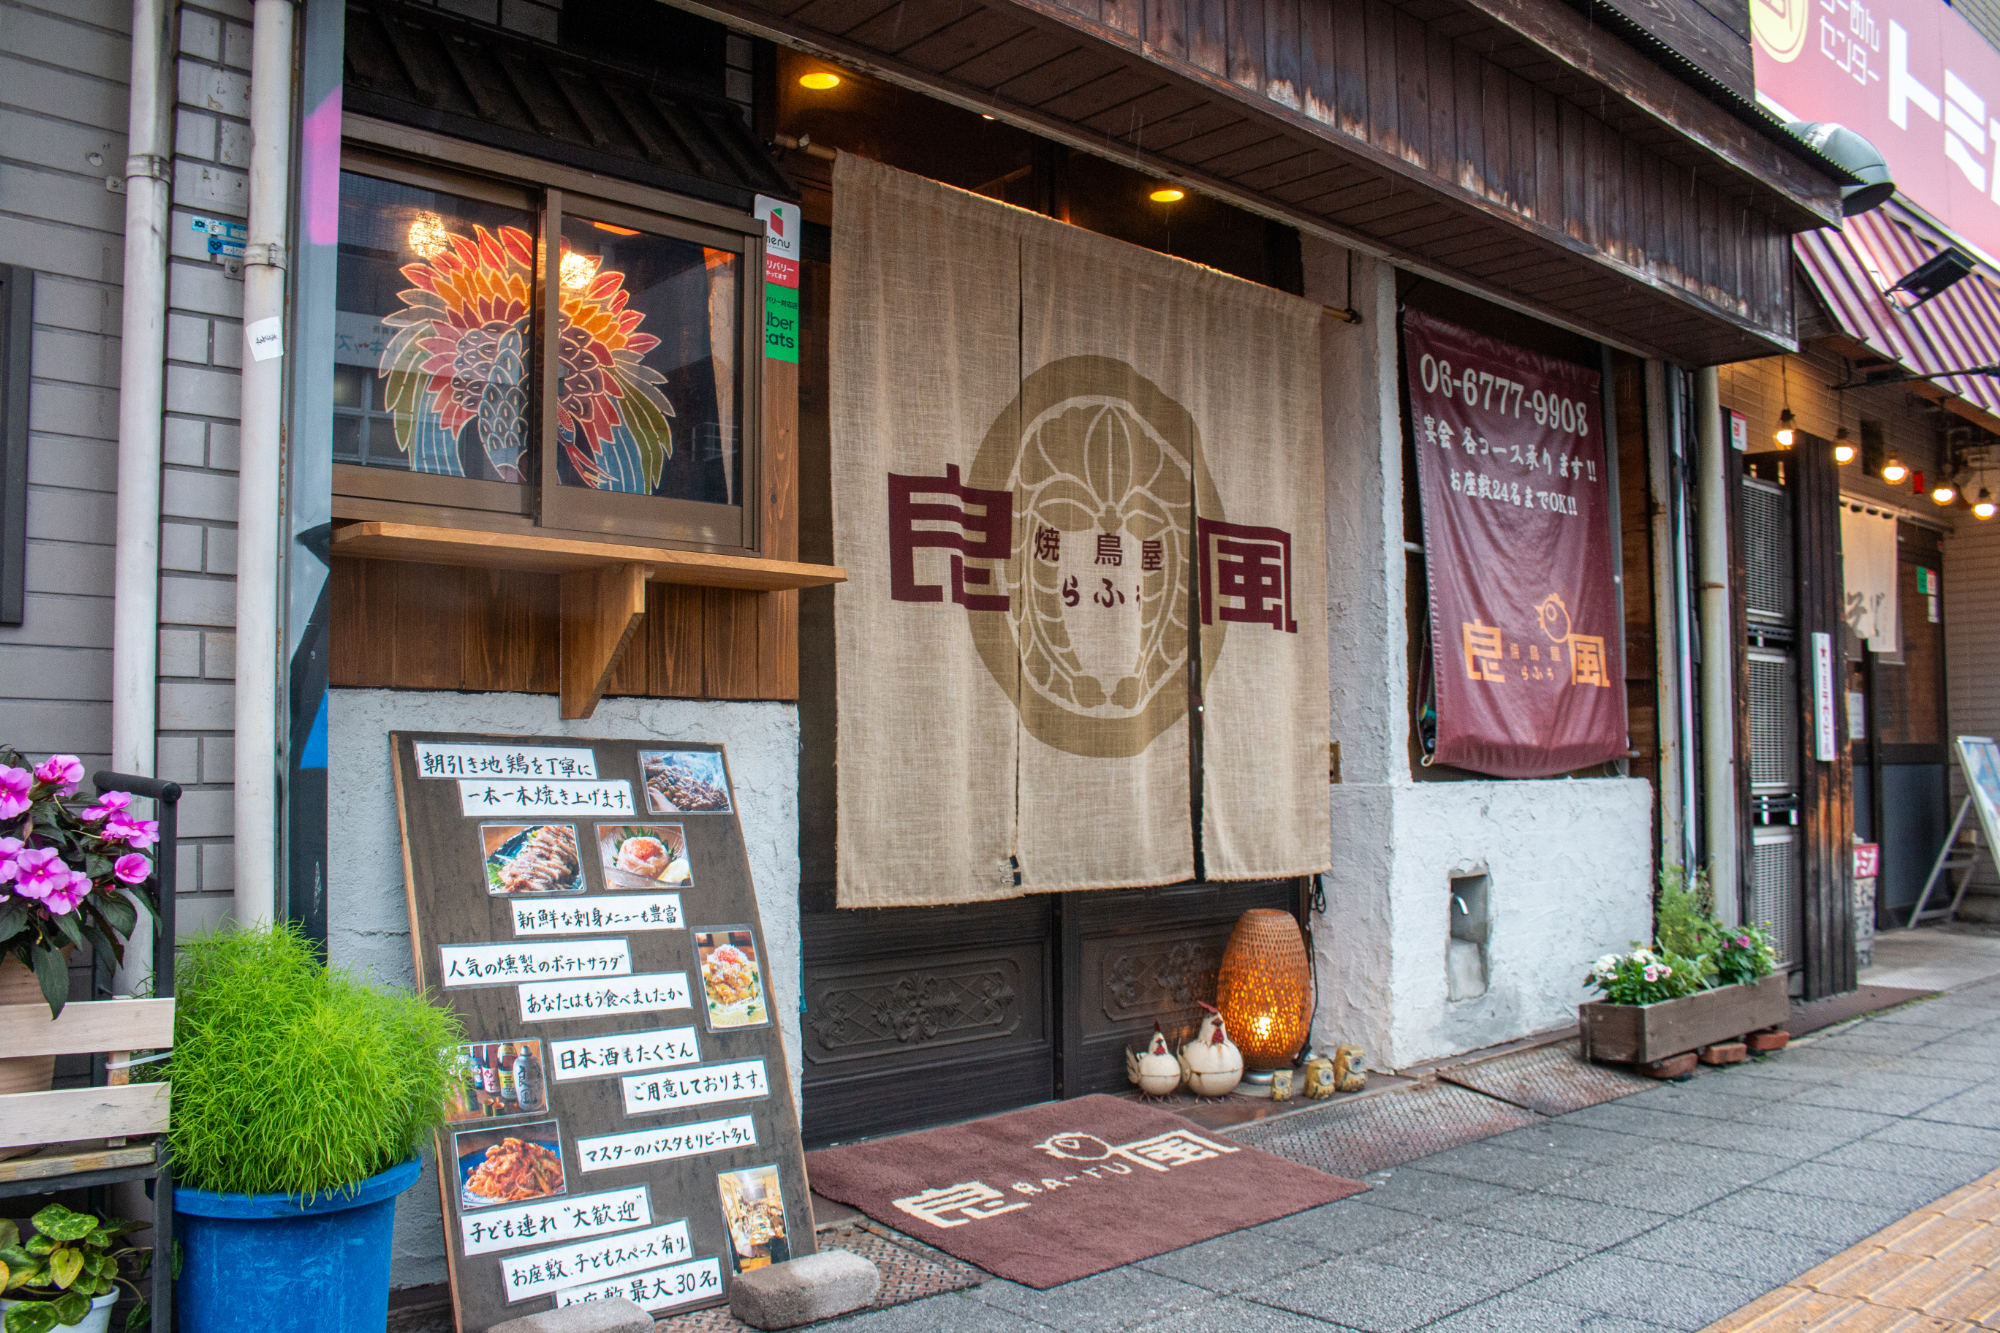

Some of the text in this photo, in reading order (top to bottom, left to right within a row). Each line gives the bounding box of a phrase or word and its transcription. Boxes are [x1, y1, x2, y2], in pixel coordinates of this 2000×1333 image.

[1888, 18, 2000, 208] トミ
[1420, 353, 1589, 437] 06-6777-9908
[423, 751, 593, 778] 朝引き地鶏を丁寧に
[467, 785, 631, 810] 一本一本焼き上げます。
[517, 903, 678, 930] 新鮮な刺身メニューも豊富
[448, 953, 626, 979] 人気の燻製のポテトサラダ
[526, 986, 684, 1014] あなたはもう食べましたか
[560, 1041, 694, 1071] 日本酒もたくさん
[633, 1068, 765, 1102] ご用意しております。
[584, 1126, 753, 1163] マスターのパスタもリピート多し
